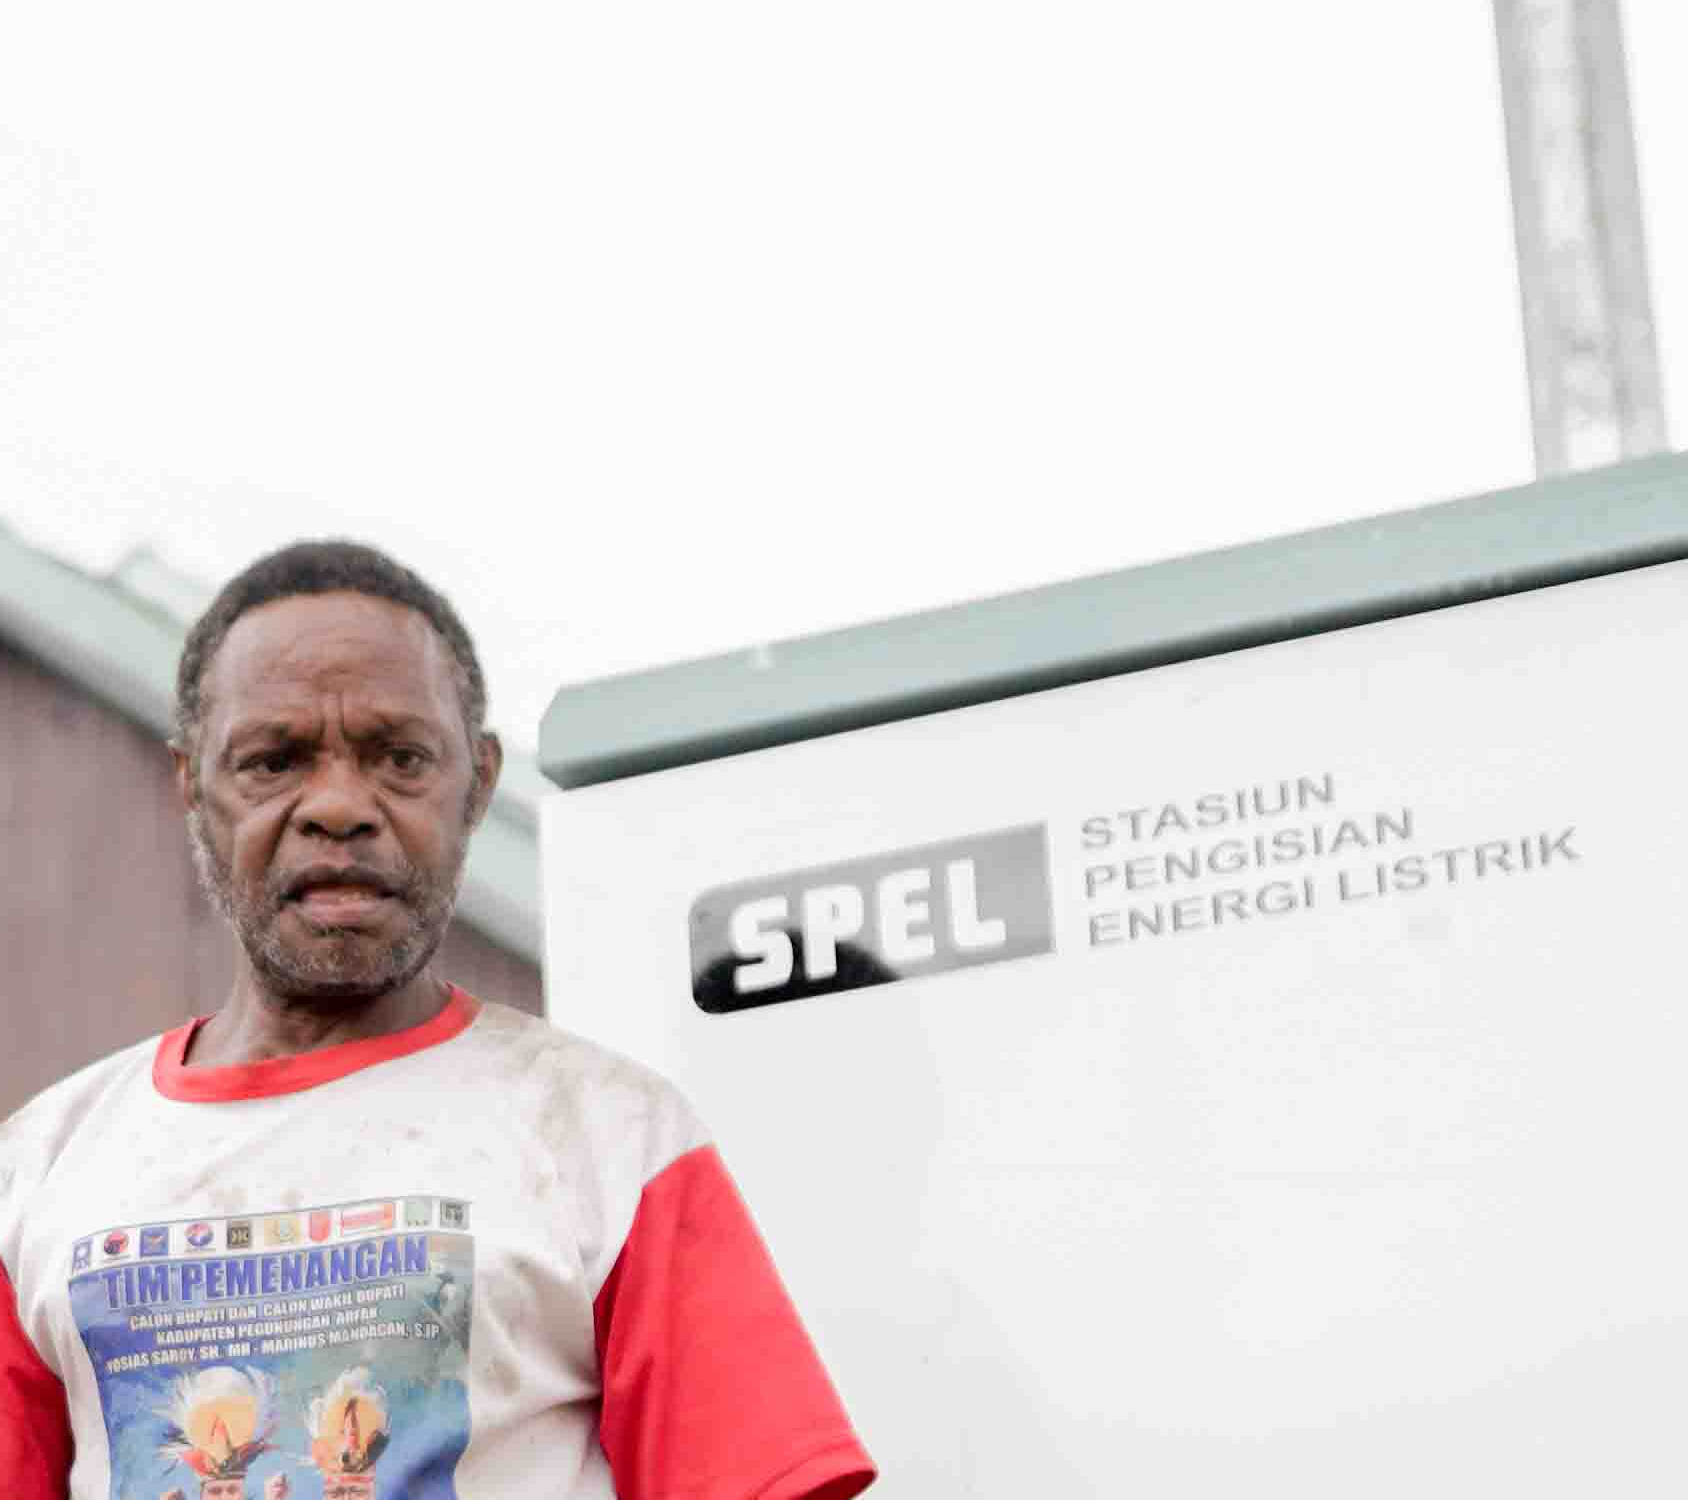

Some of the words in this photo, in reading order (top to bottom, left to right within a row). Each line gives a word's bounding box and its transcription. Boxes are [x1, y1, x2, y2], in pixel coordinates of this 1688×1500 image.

[1078, 774, 1336, 850] STASIUN
[1082, 807, 1414, 898] PENGISIAN
[732, 858, 1008, 992] SPEL
[1085, 874, 1315, 946] ENERGI
[1336, 826, 1578, 902] LISTRIK
[102, 1263, 170, 1309] TIM
[180, 1236, 429, 1302] PEMENANGAN
[262, 1298, 308, 1318] CALON
